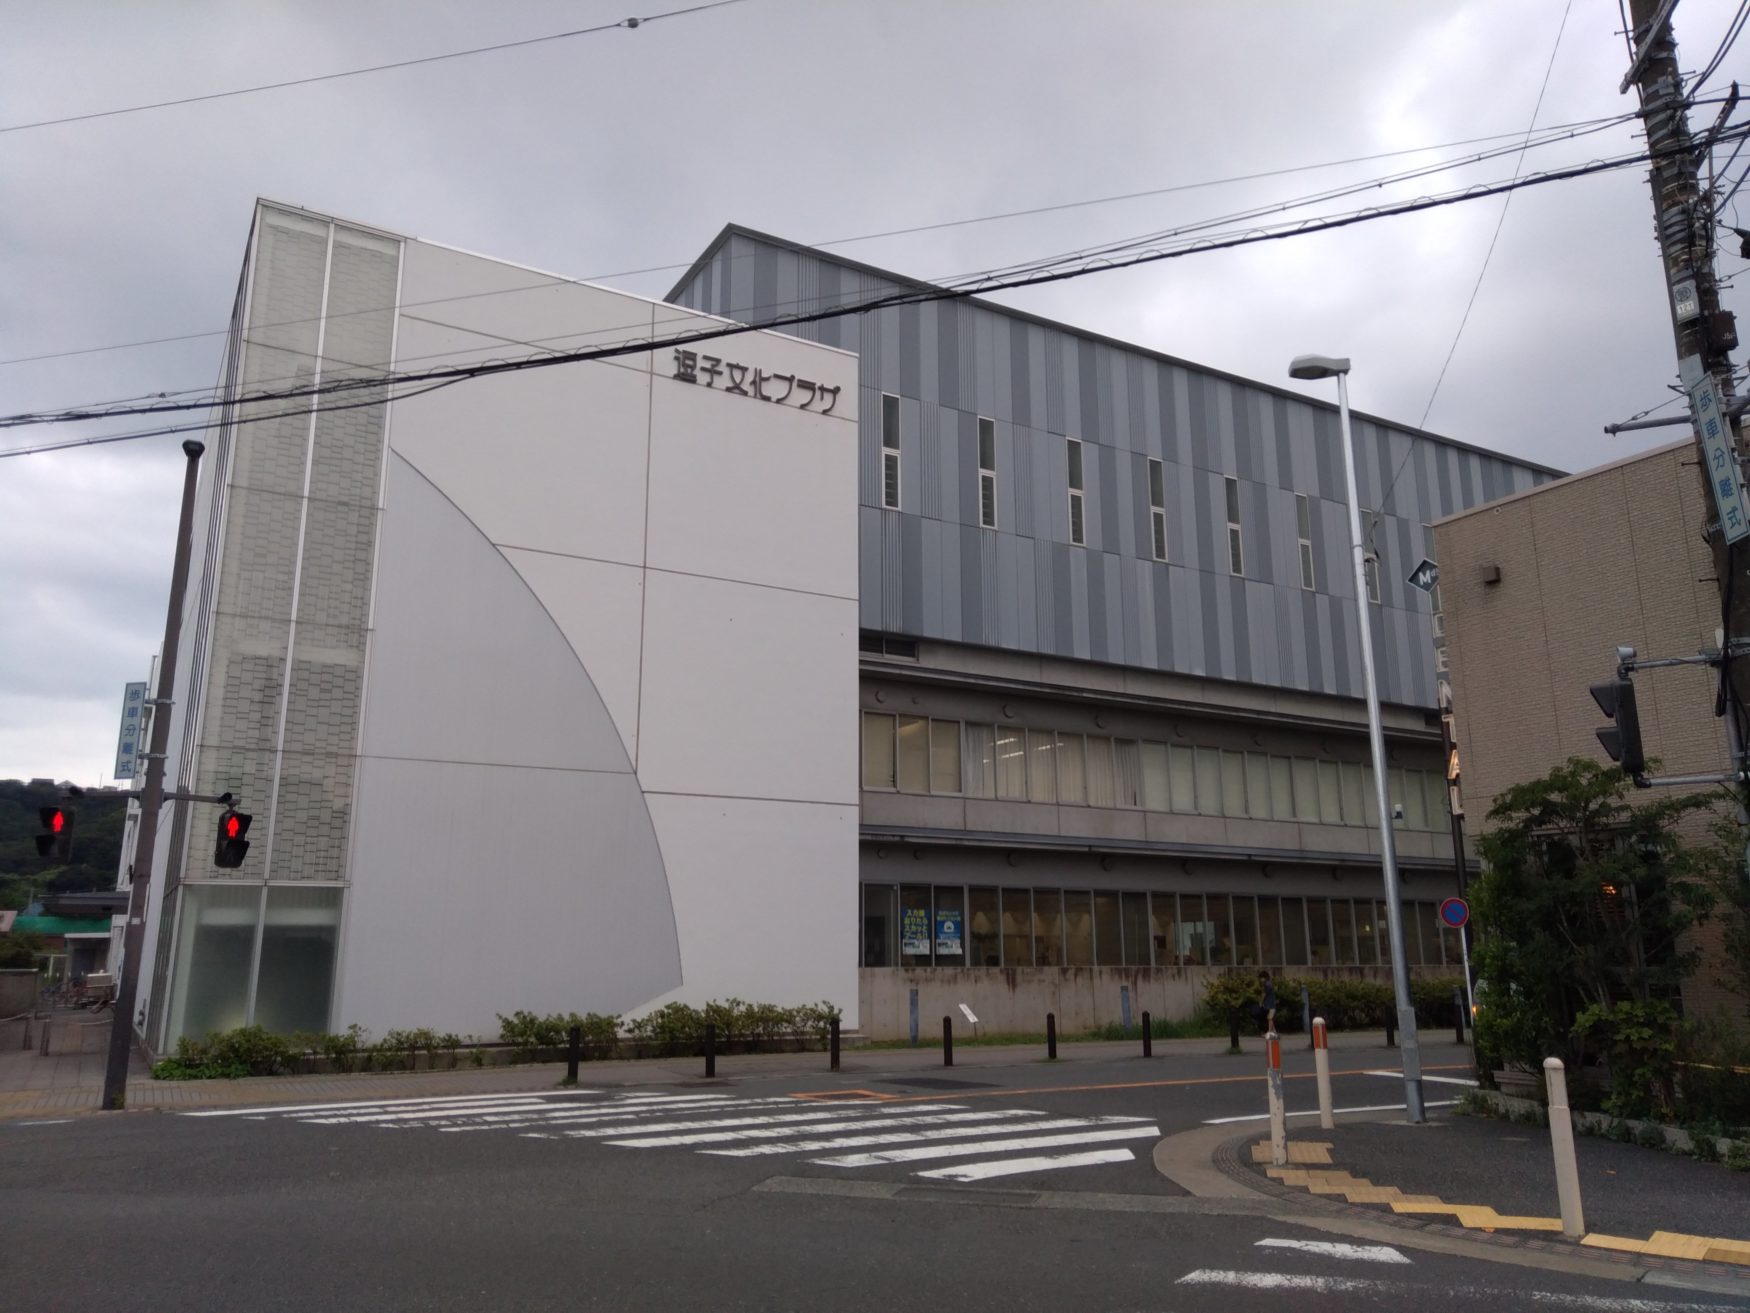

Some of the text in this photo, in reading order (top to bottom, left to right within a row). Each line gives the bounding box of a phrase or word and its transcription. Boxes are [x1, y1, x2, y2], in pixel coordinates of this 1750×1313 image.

[673, 348, 841, 415] 逗子文化プラザ
[1700, 389, 1742, 529] 歩車分離式
